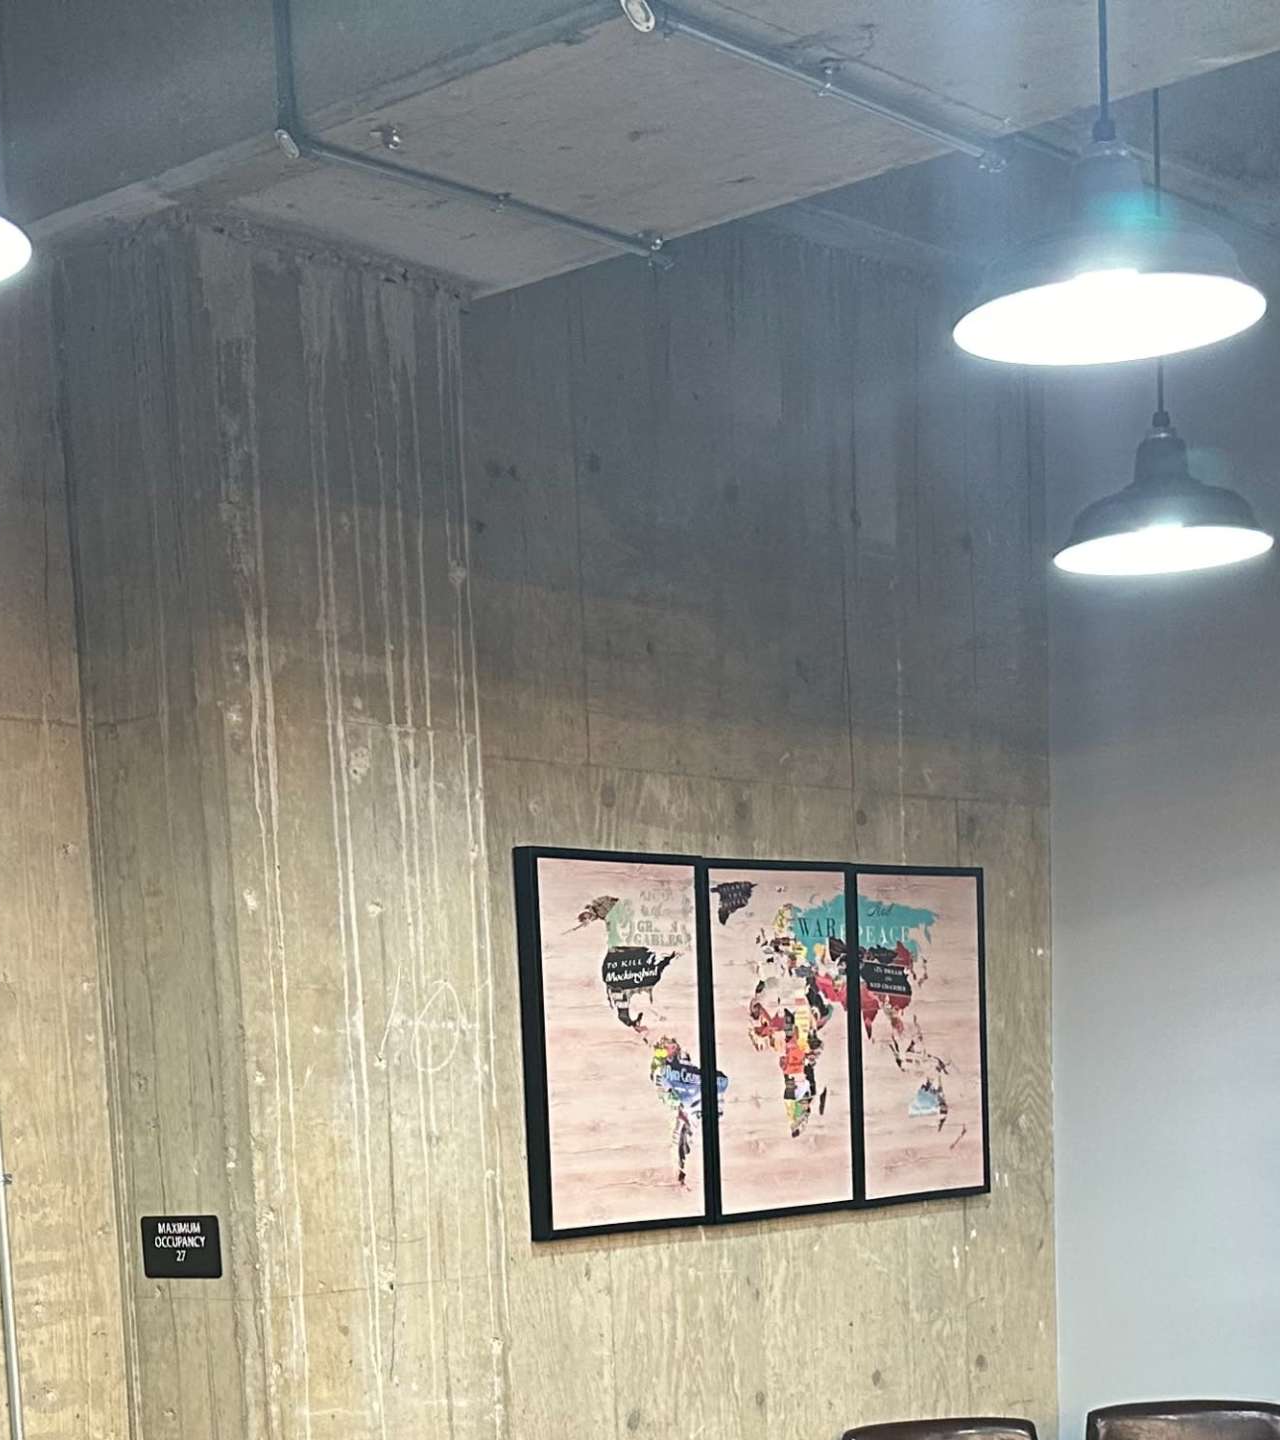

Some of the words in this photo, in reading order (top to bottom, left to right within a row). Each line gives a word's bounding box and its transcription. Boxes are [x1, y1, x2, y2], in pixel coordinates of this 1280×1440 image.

[797, 917, 836, 938] WAR
[606, 960, 618, 970] TO
[621, 958, 642, 968] KILL
[157, 1222, 201, 1234] MAXIMUM
[154, 1236, 206, 1248] OCCUPANCY
[176, 1250, 186, 1262] 27
